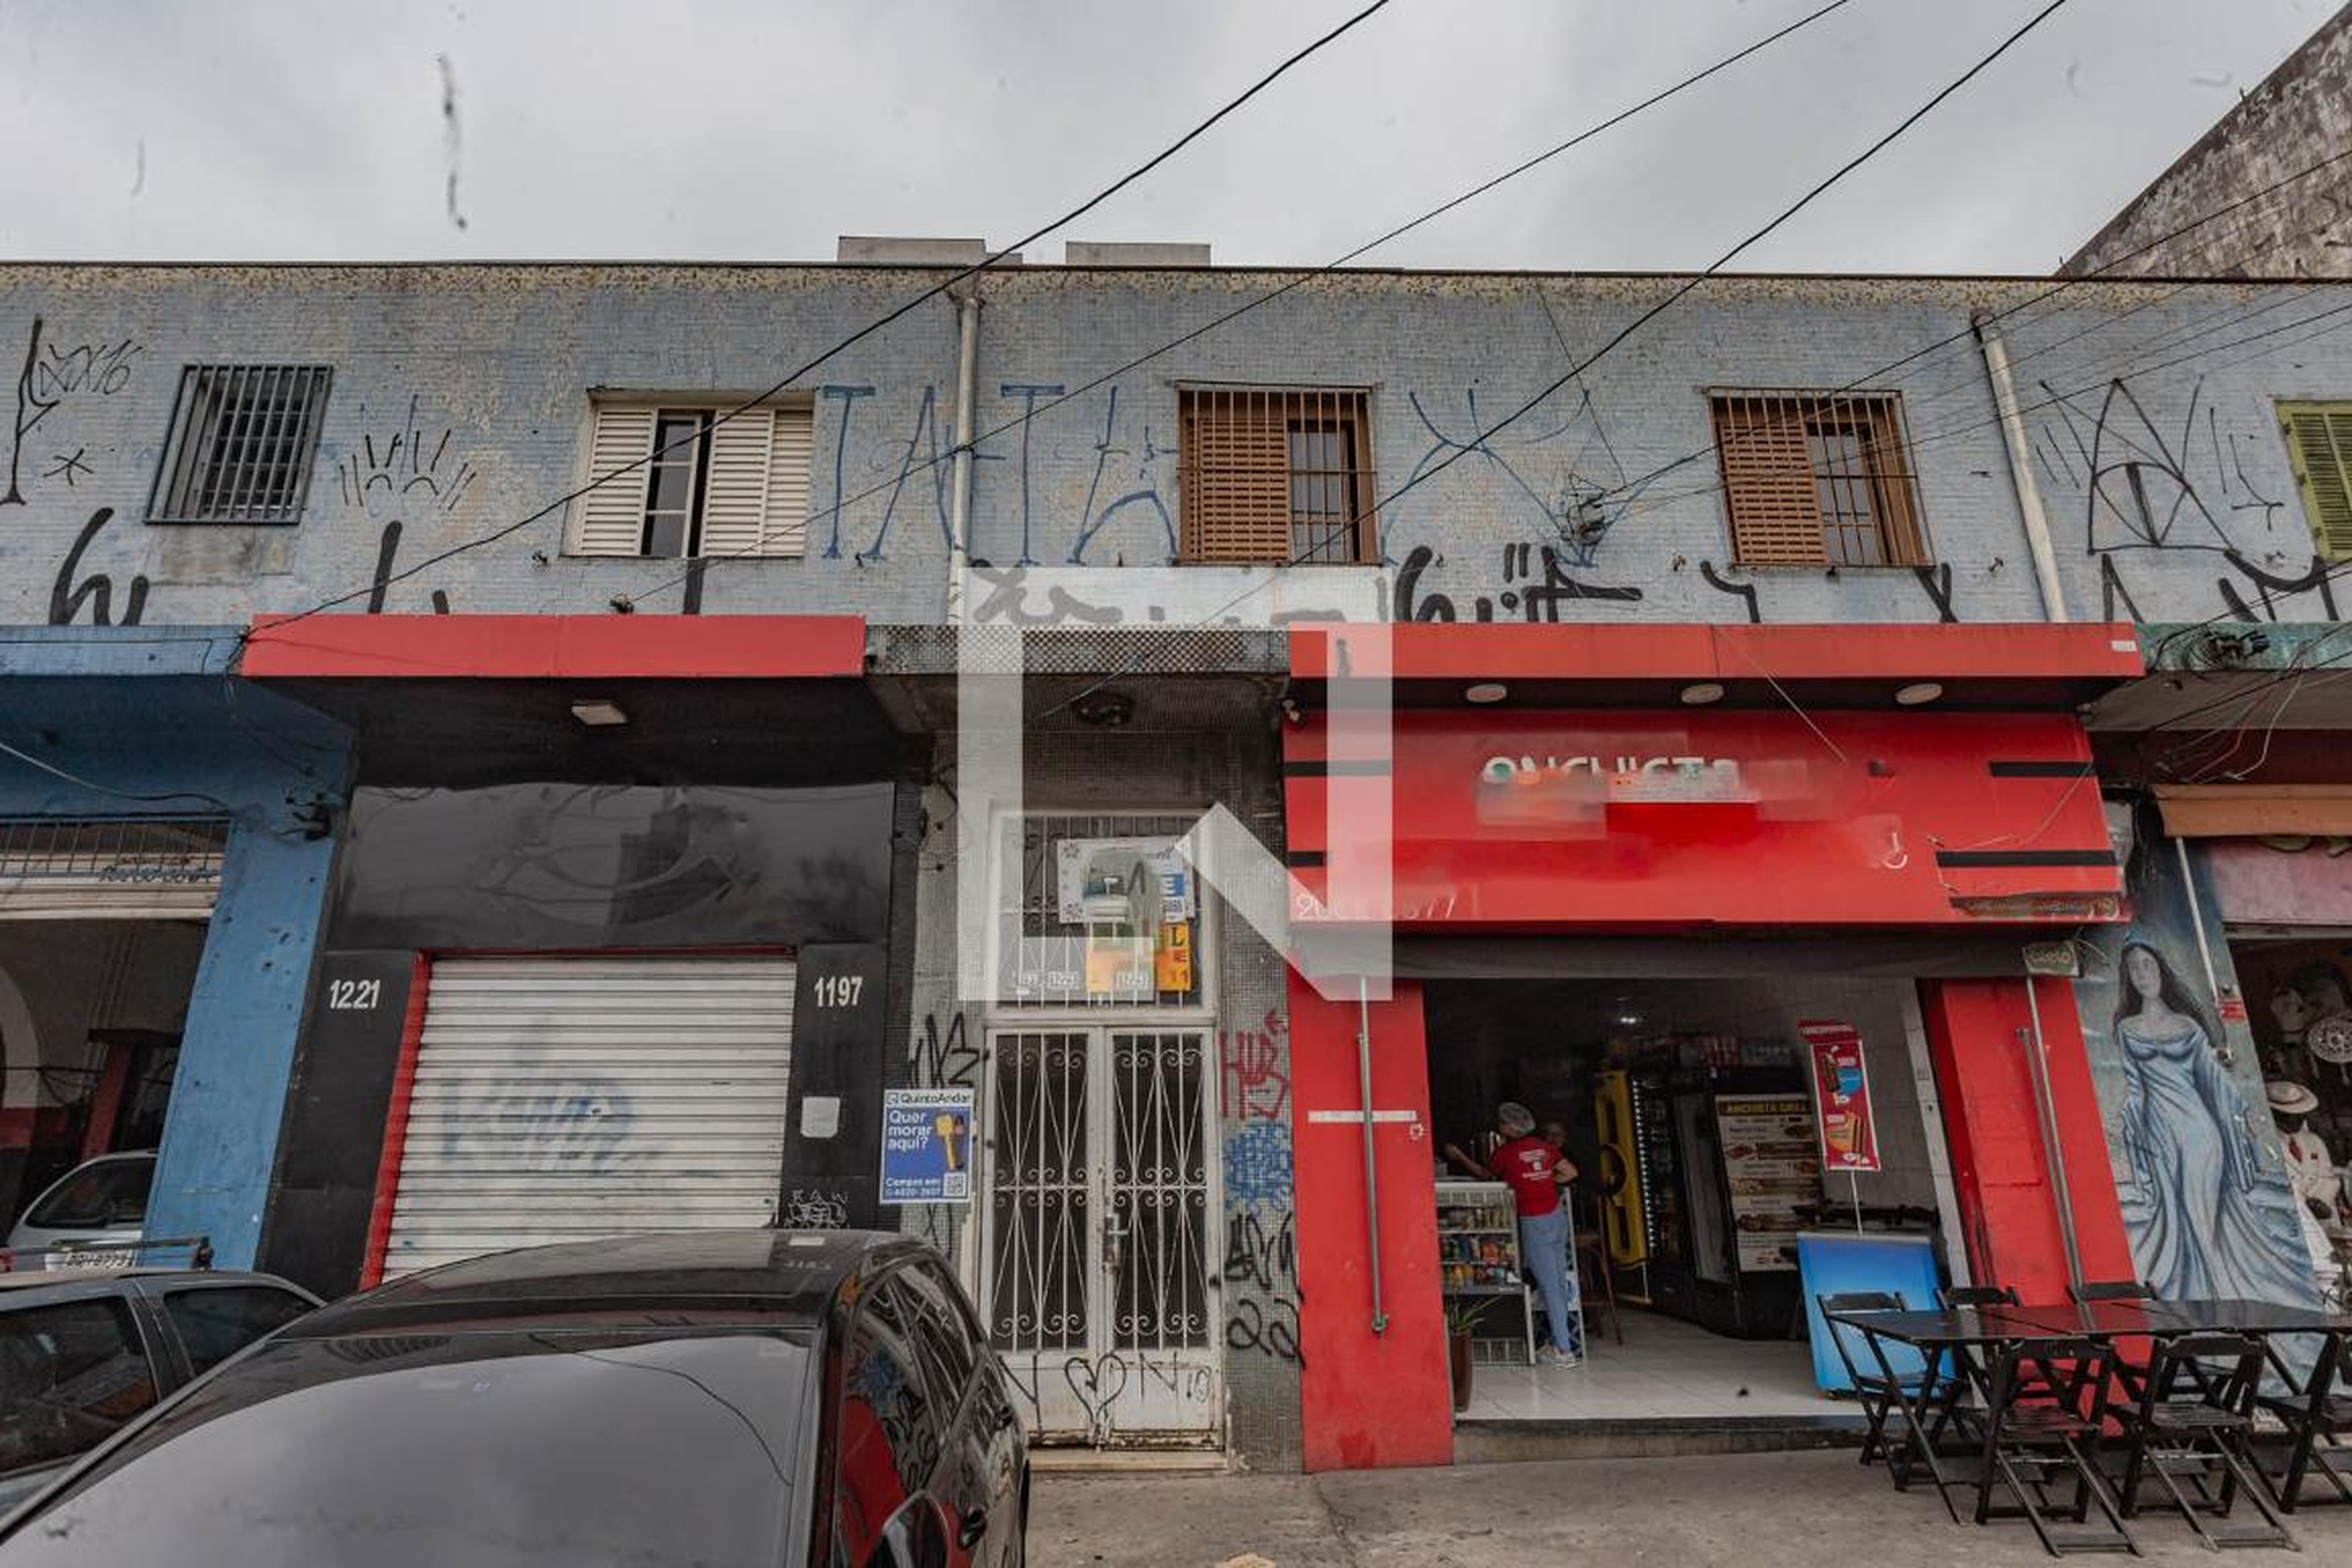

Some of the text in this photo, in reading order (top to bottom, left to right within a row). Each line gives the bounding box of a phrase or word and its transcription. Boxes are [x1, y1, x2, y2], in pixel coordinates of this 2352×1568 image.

[330, 980, 380, 1009] 1221
[814, 976, 863, 1007] 1197
[889, 1110, 927, 1123] Quer
[888, 1125, 932, 1136] morar
[888, 1135, 929, 1152] aqui?
